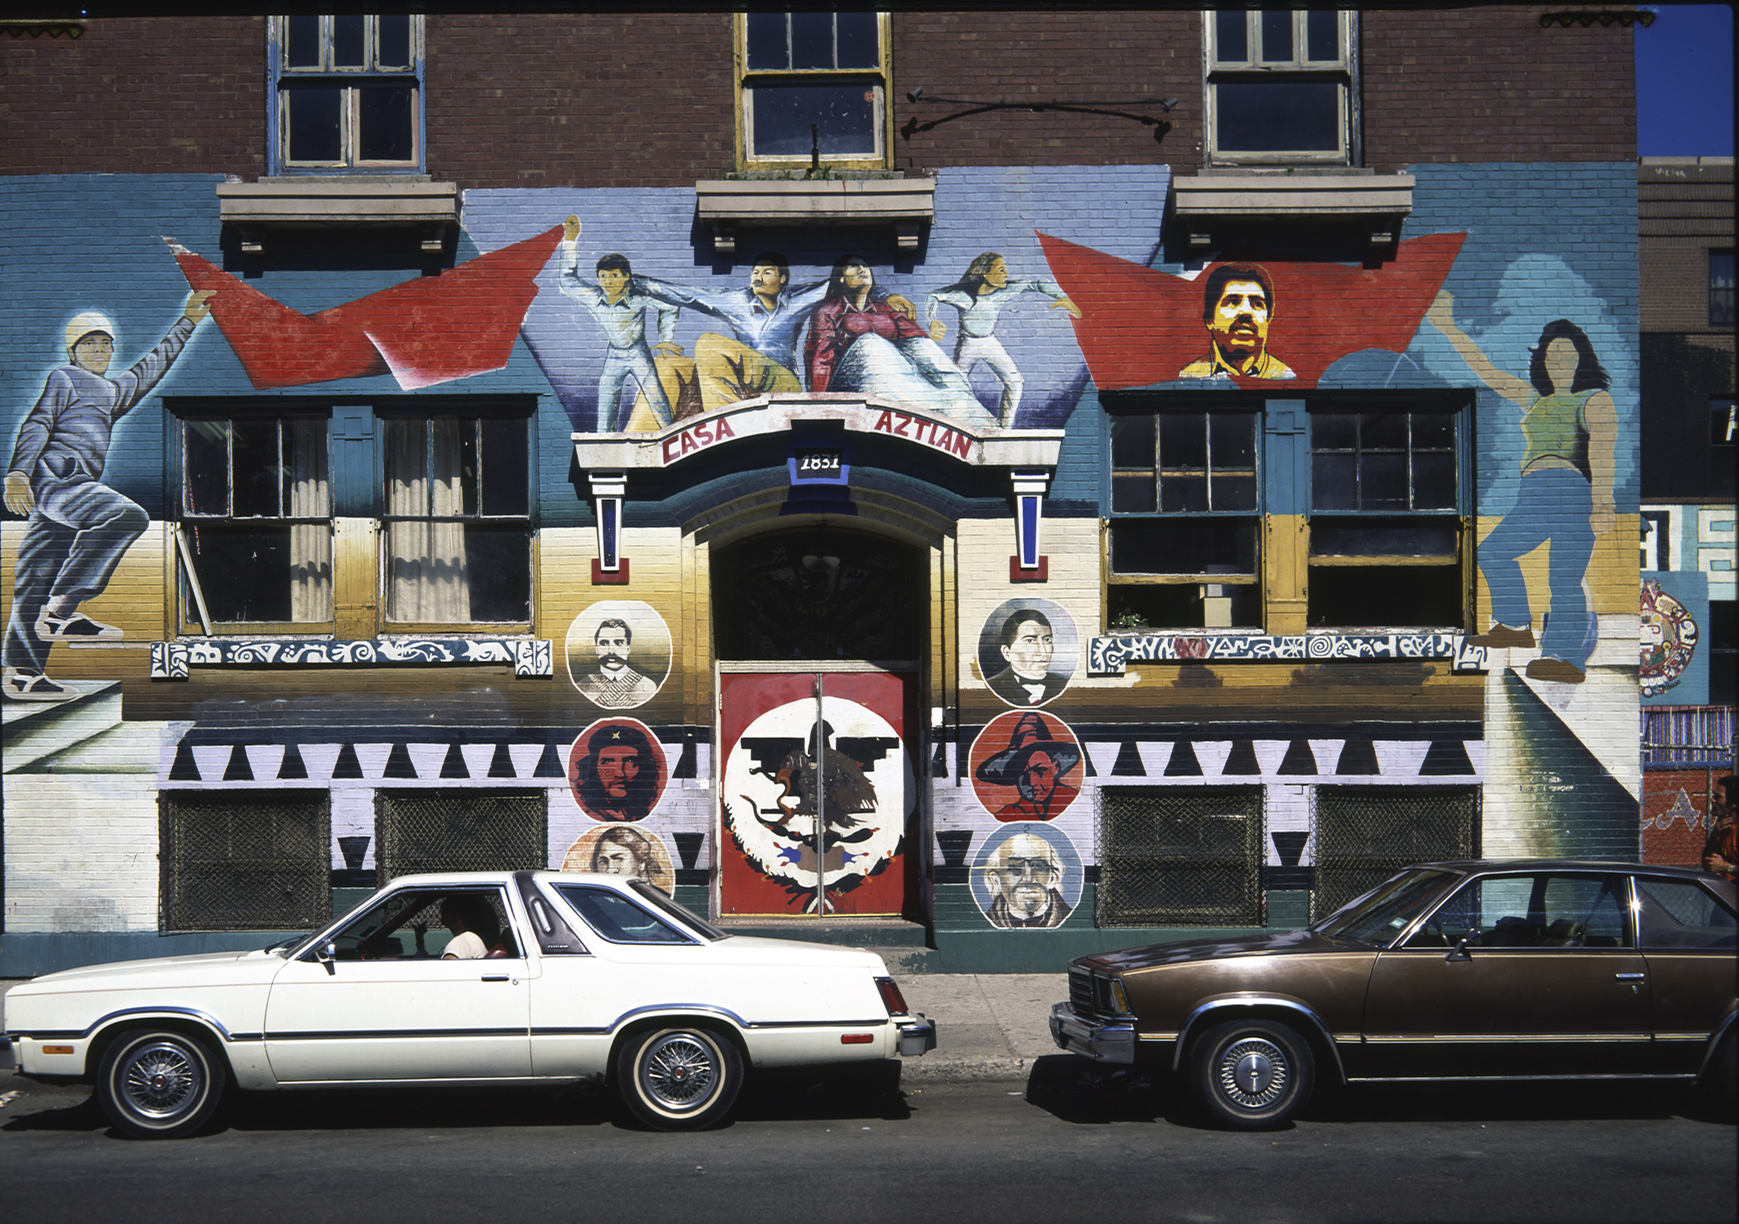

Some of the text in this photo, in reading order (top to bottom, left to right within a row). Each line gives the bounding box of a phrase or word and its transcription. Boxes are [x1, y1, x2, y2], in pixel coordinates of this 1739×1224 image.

[662, 410, 973, 465] CASA AZTLAN
[801, 453, 840, 471] 1831
